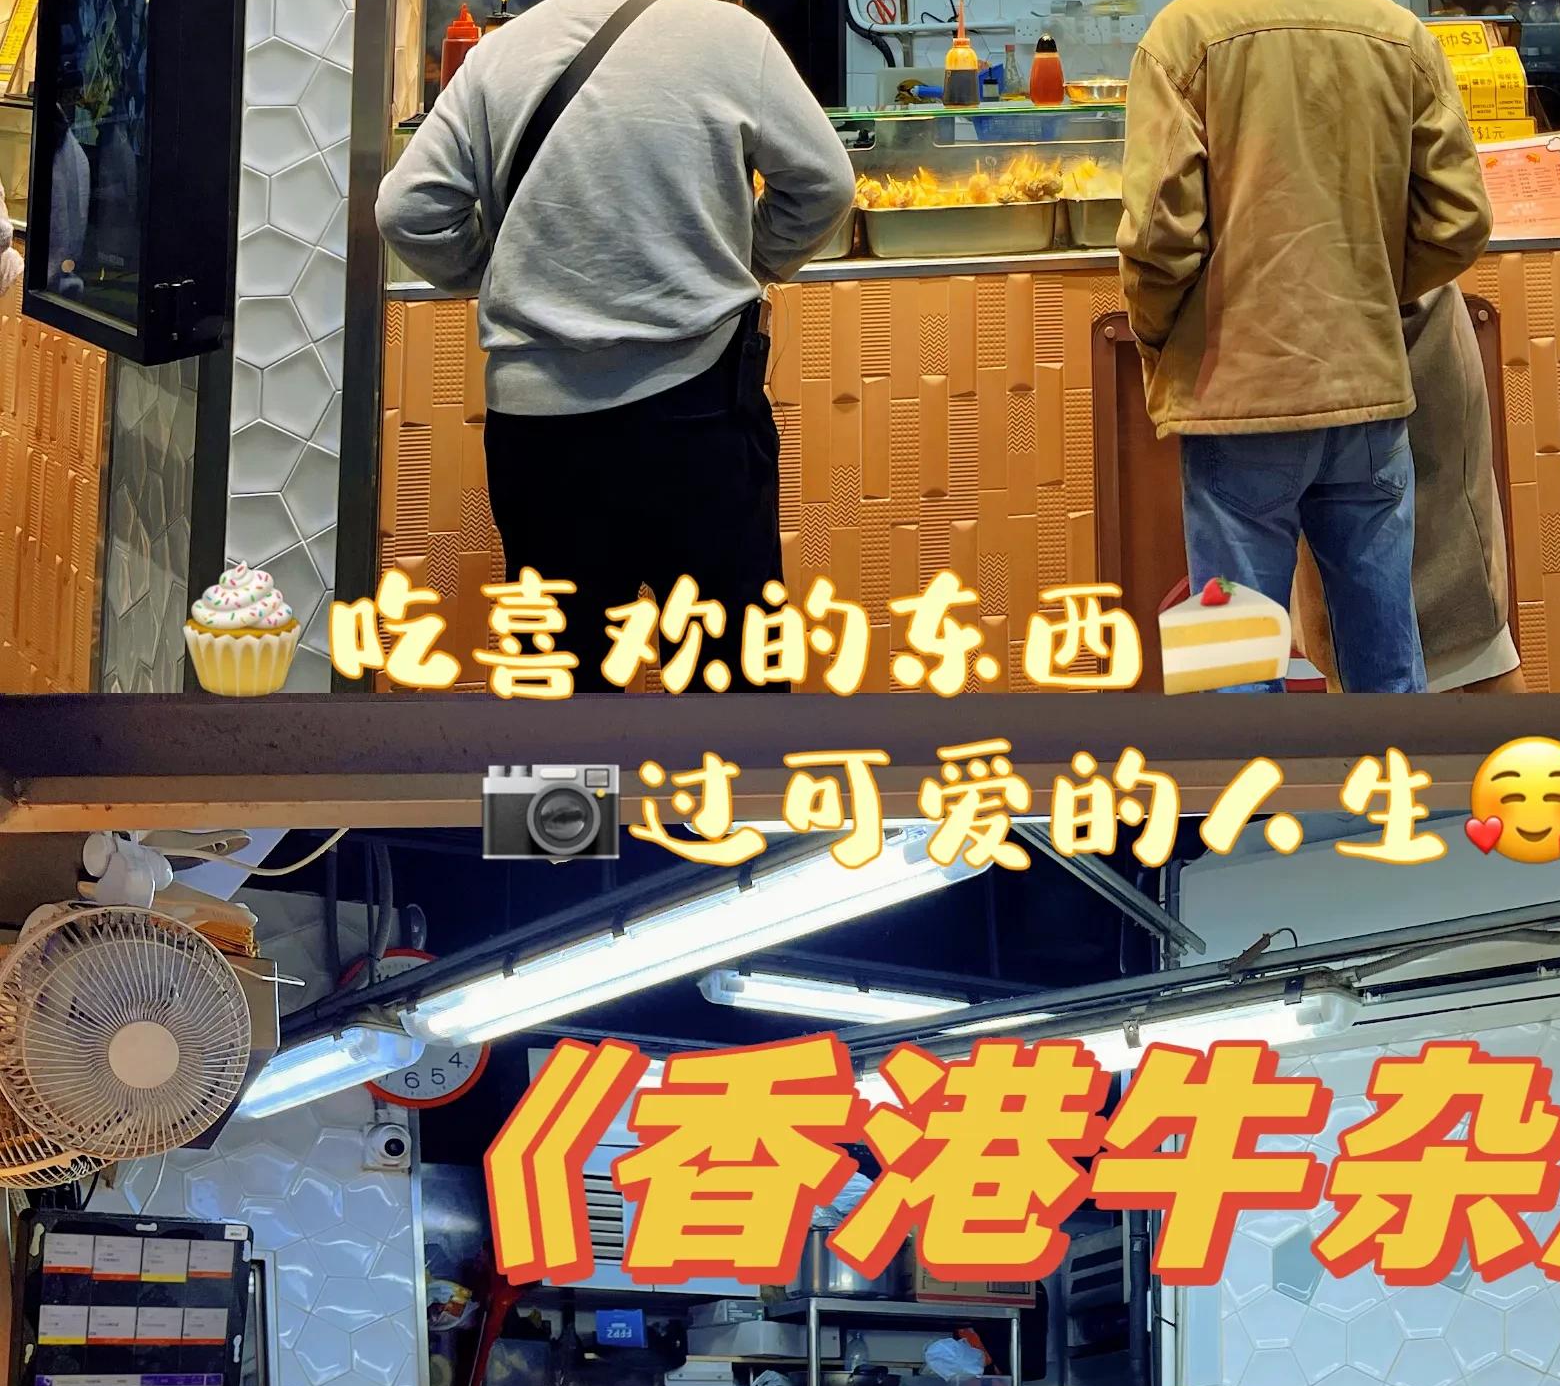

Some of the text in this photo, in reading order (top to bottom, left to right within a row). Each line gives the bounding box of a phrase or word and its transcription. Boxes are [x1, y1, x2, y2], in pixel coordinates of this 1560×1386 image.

[448, 1052, 463, 1069] 4
[404, 1068, 446, 1089] 6 5
